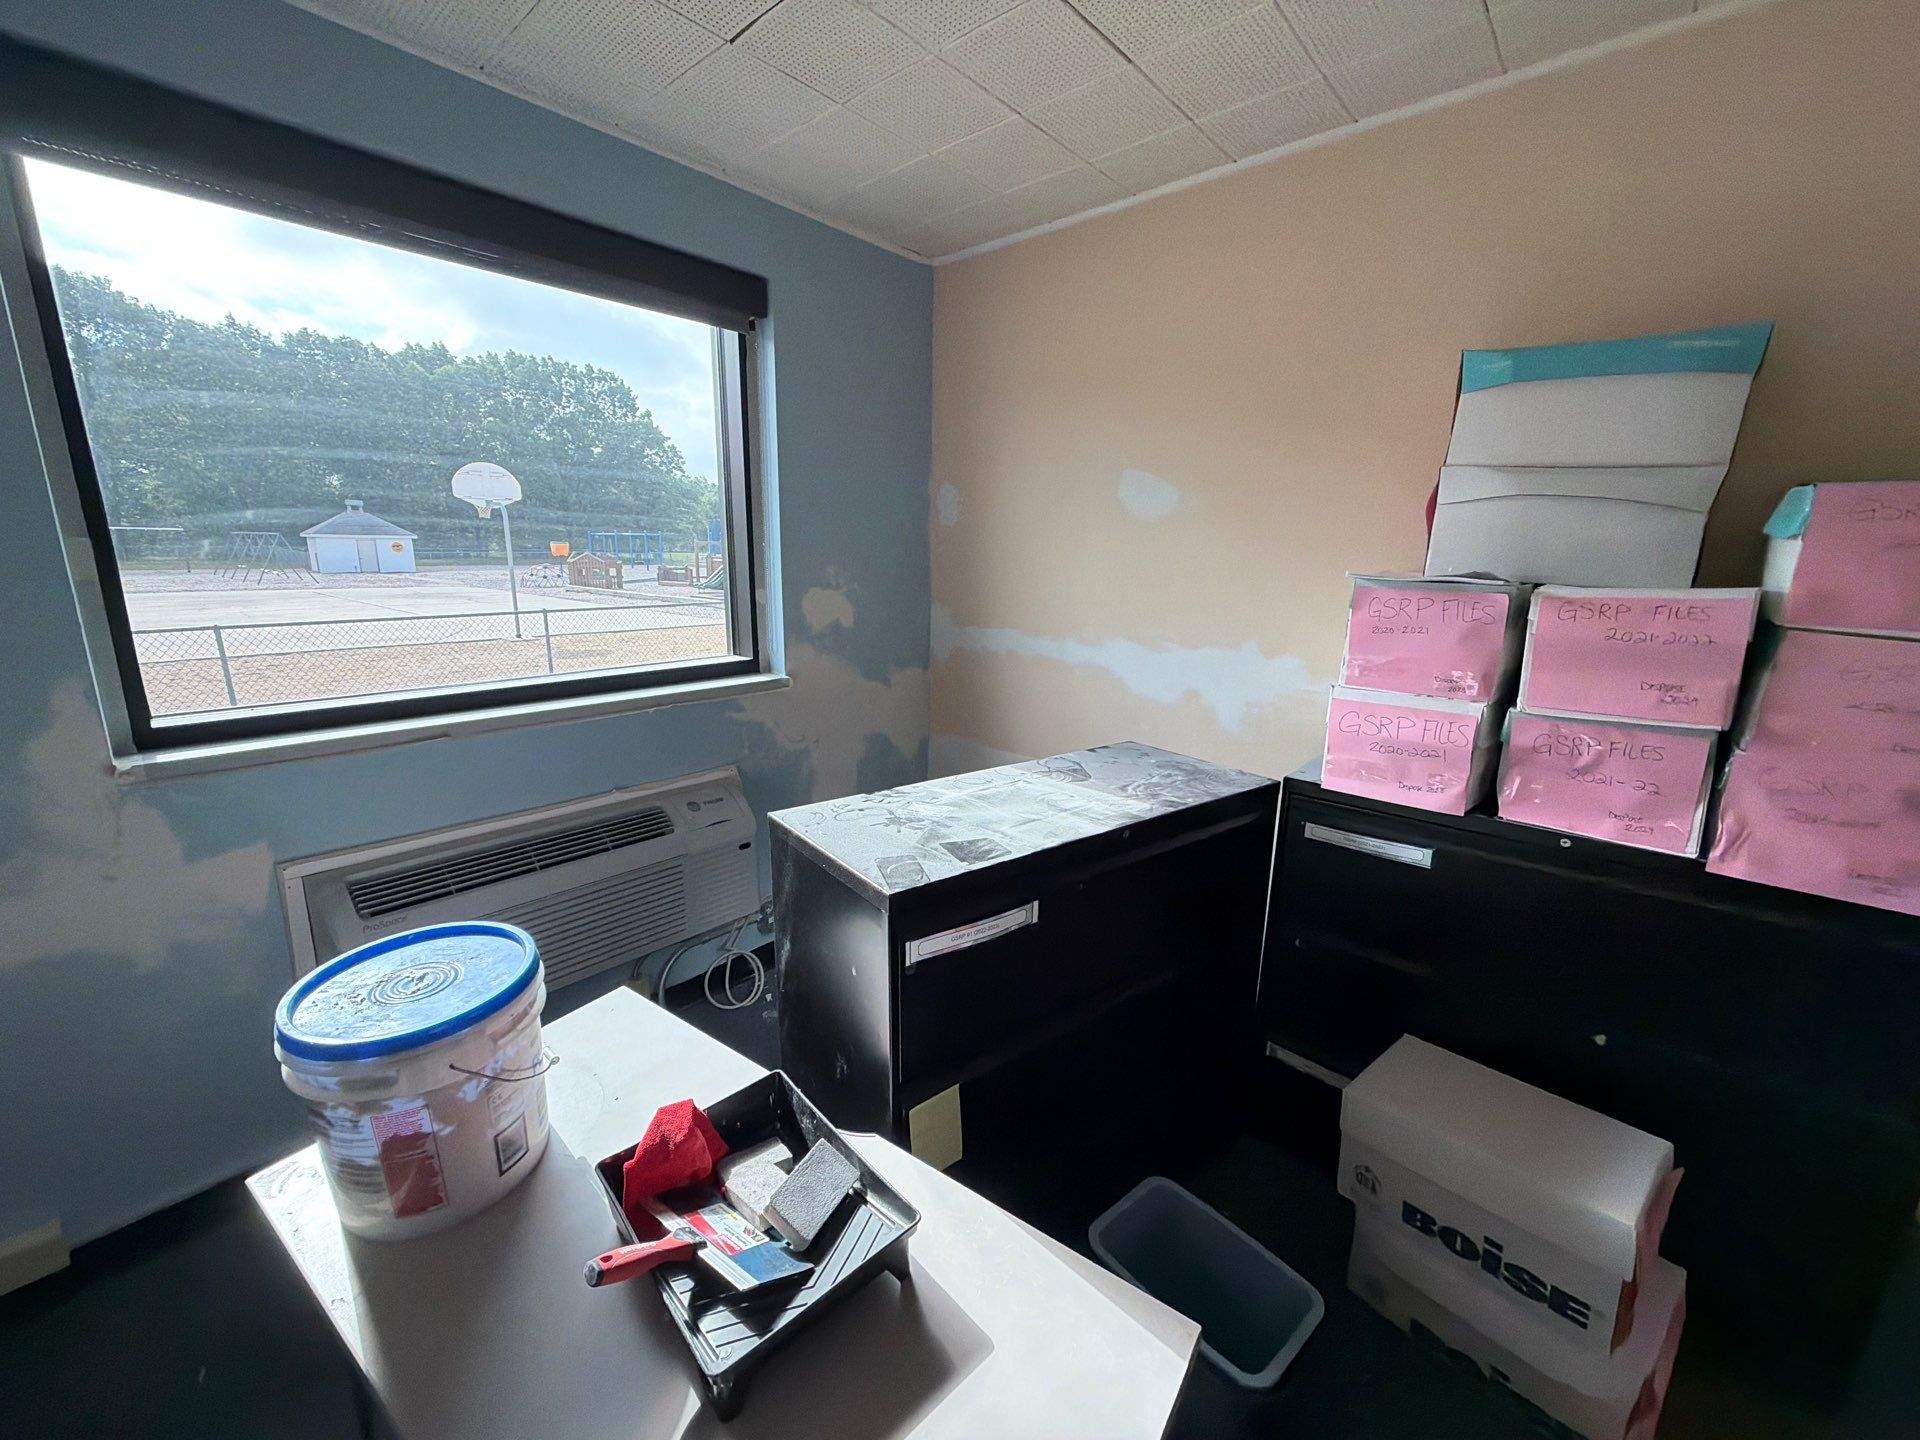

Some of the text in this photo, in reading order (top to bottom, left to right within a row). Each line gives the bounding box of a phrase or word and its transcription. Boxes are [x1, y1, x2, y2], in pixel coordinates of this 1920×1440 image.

[1368, 596, 1498, 625] GSRP FILES
[1557, 601, 1712, 623] GSRP FILES
[1371, 625, 1430, 636] 2020-2021
[1603, 626, 1718, 647] 2021-2022
[1338, 710, 1470, 748] GSRP FILES
[1368, 741, 1448, 763] 2020-2021
[1531, 732, 1666, 762] GSRP FILES
